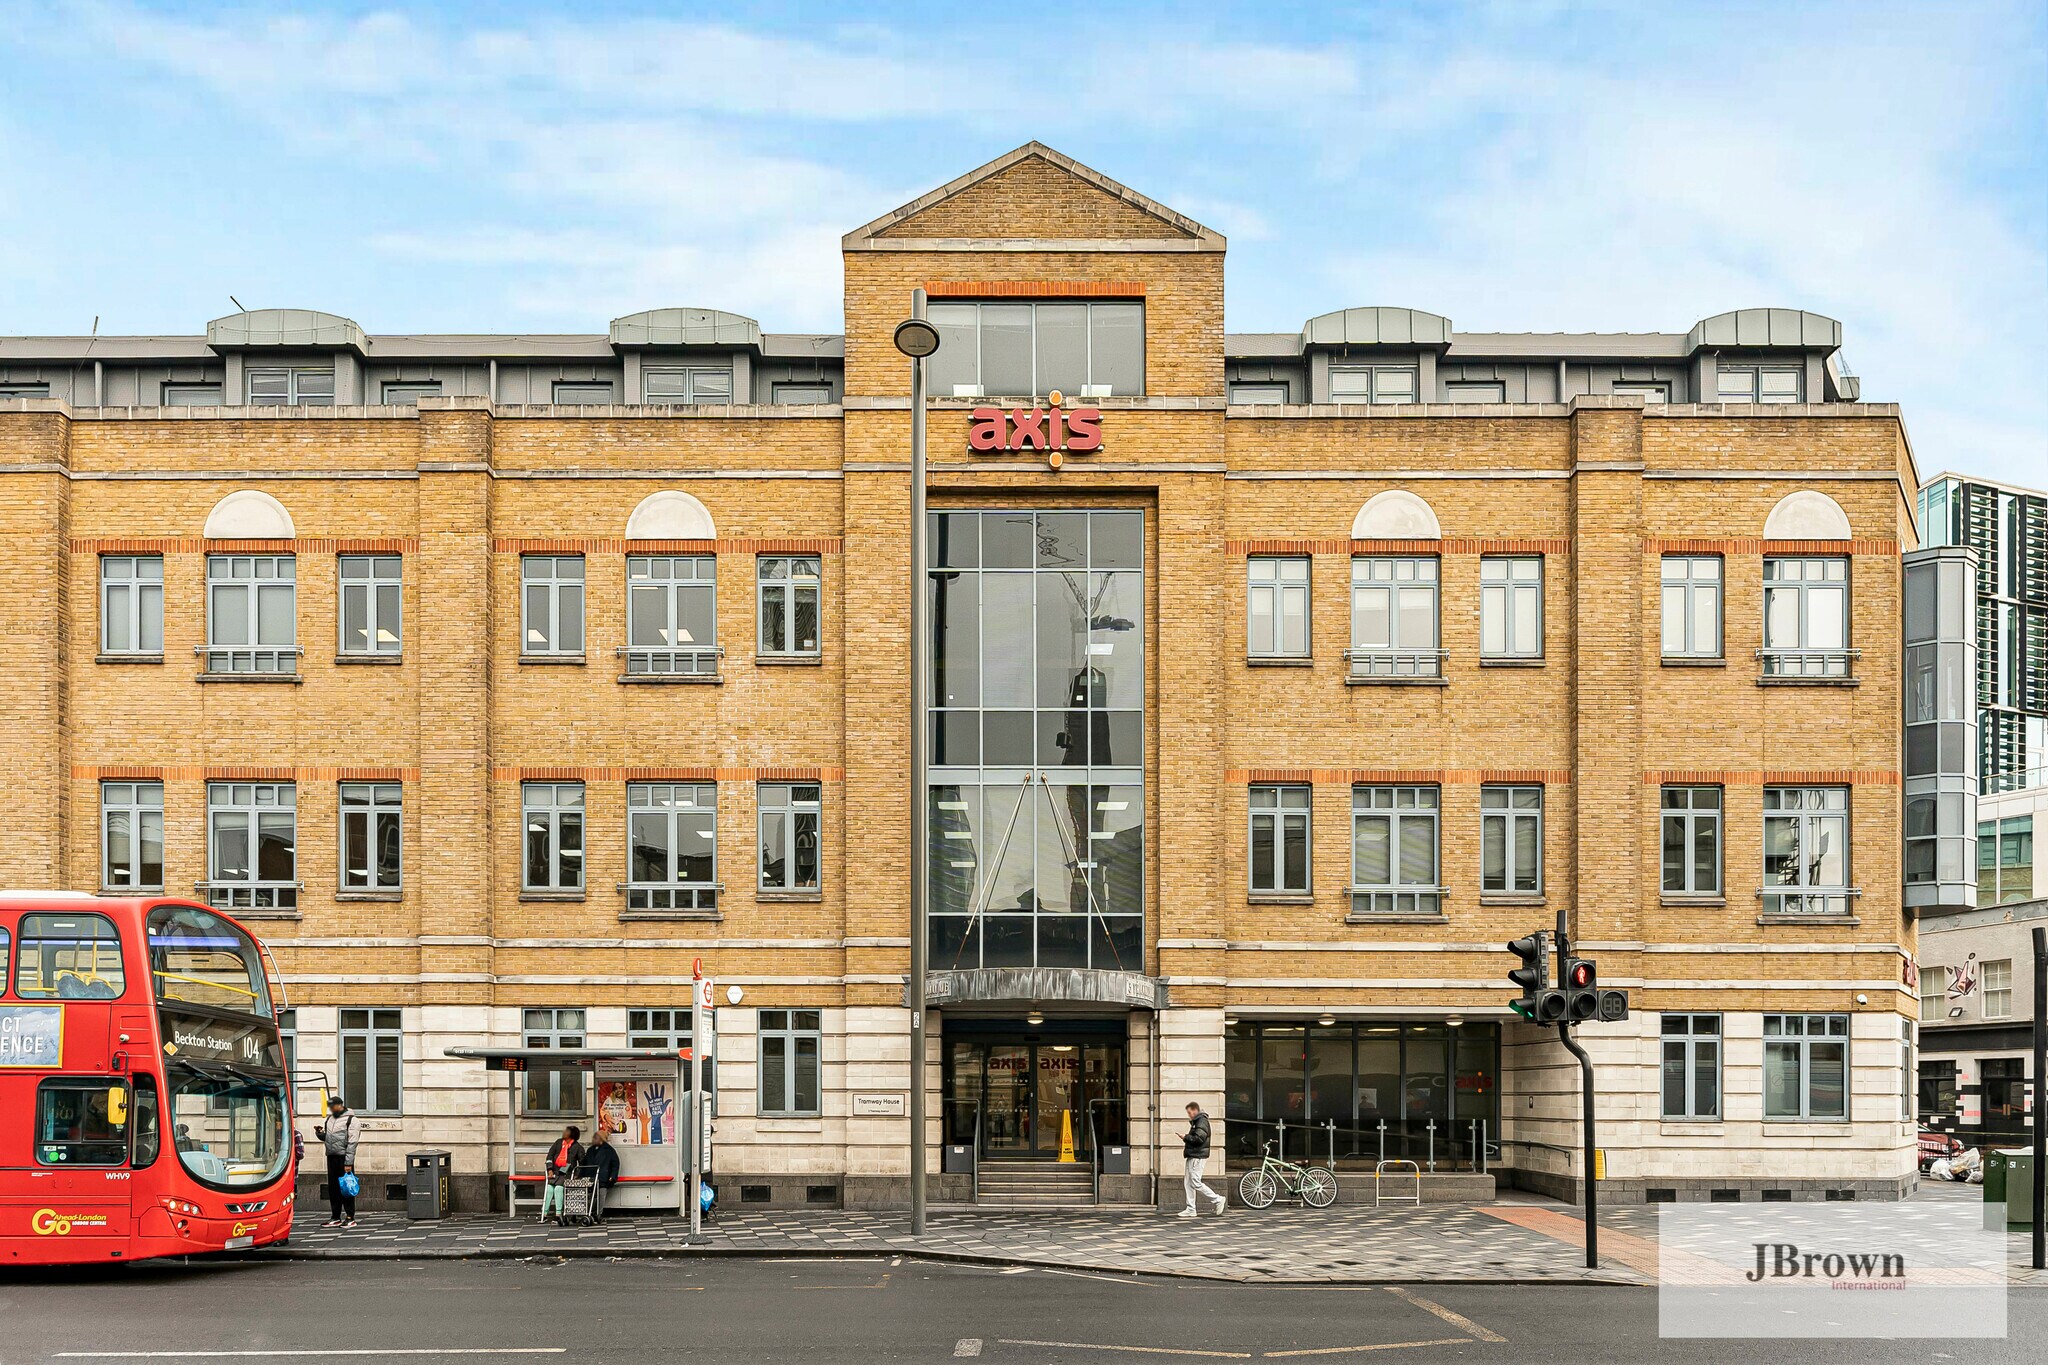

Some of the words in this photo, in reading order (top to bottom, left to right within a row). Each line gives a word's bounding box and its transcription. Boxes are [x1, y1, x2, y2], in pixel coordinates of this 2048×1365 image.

[970, 390, 1102, 468] axis
[174, 1031, 206, 1048] Beckton
[207, 1036, 233, 1051] Station
[243, 1037, 260, 1059] 104
[990, 1053, 1027, 1072] axis
[1040, 1054, 1078, 1073] axis
[858, 1098, 882, 1106] Tramway
[105, 1172, 131, 1181] WHV9
[31, 1208, 71, 1236] Go
